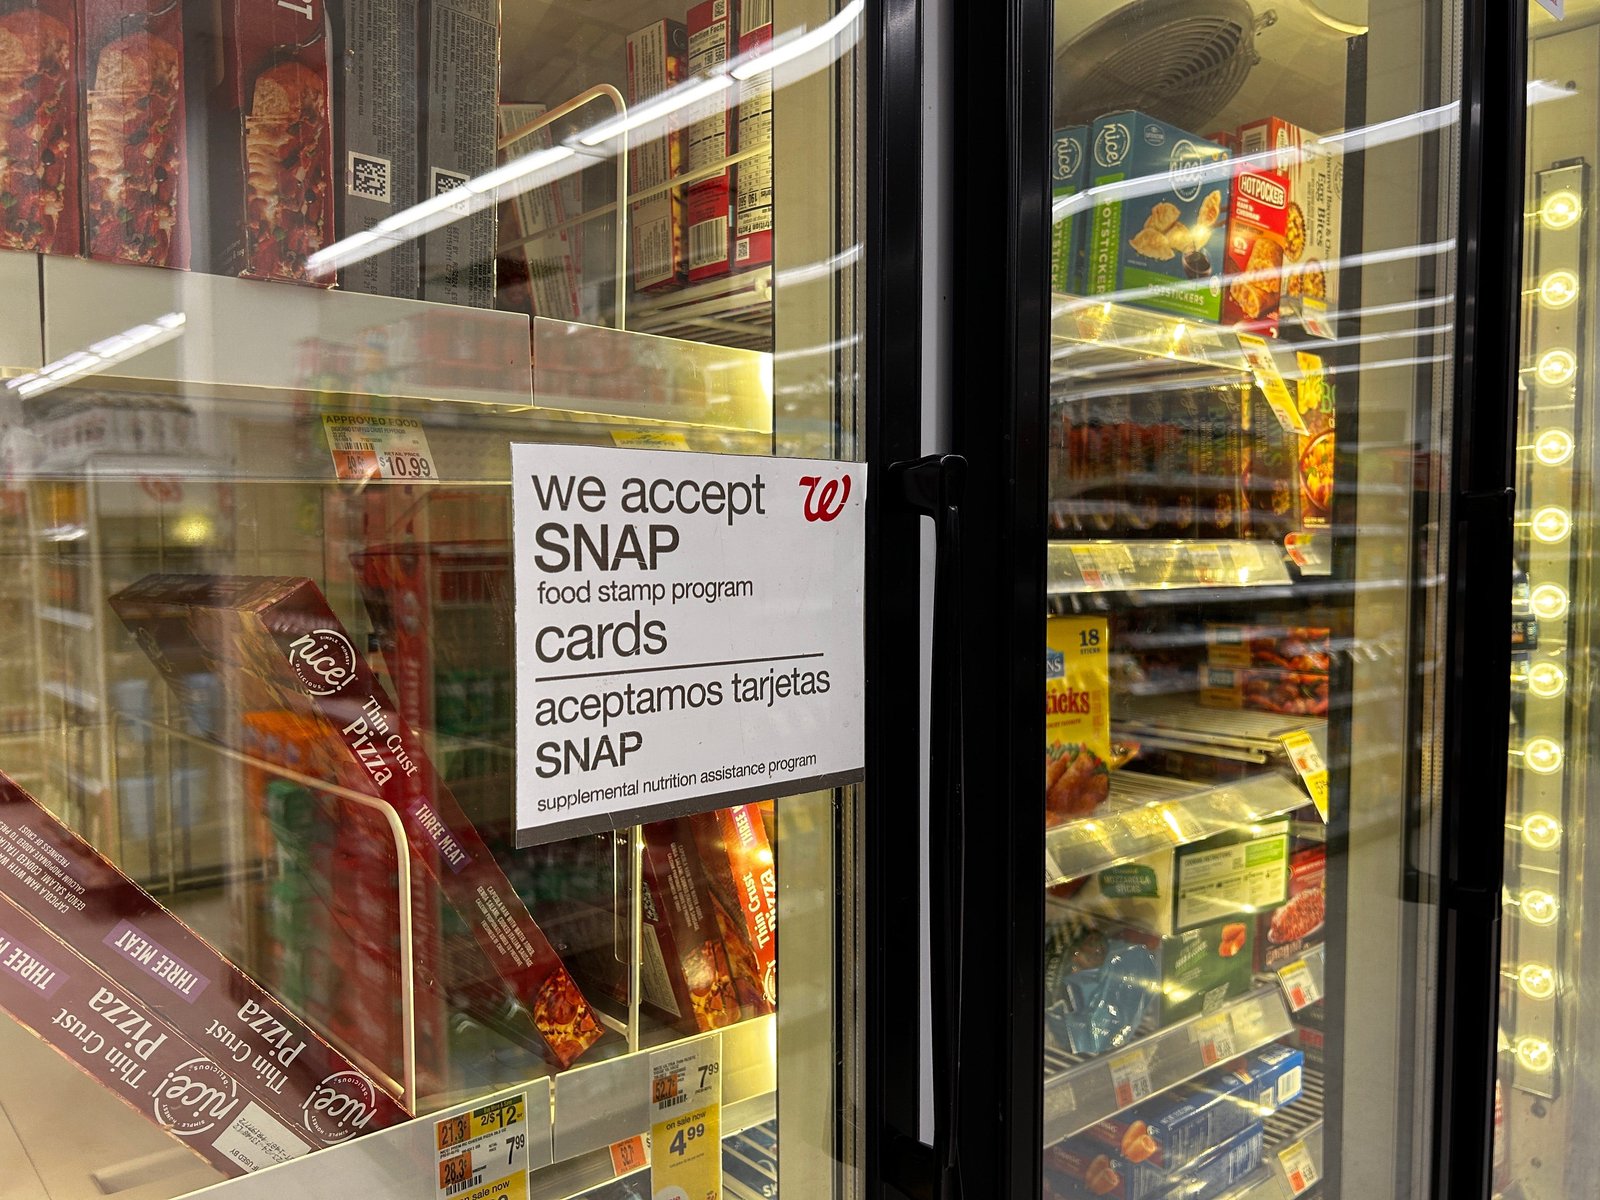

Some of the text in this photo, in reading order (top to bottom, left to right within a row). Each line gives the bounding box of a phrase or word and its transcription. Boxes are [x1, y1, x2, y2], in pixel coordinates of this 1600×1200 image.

[710, 22, 724, 34] Facts
[738, 224, 752, 234] Facts
[1096, 198, 1112, 294] POTSTICKER
[1317, 208, 1325, 247] Bites
[326, 415, 418, 428] APPROVED FOOD
[380, 456, 431, 477] $10.99
[531, 474, 766, 526] we accept
[534, 522, 680, 573] SNAP
[537, 578, 753, 606] food stamp program
[535, 610, 668, 663] cards
[1078, 628, 1100, 647] 18
[290, 634, 356, 692] nice!
[535, 667, 830, 728] aceptamos tarjetas
[1046, 687, 1090, 714] ticks
[342, 716, 393, 787] Pizza
[362, 695, 419, 778] Thin Crust
[535, 731, 644, 778] SNAP
[537, 752, 818, 812] supplemental nutrition assistance program
[10, 830, 18, 840] TO
[16, 837, 38, 857] ADDED
[18, 824, 71, 868] FRESHNESS OF CRUST
[415, 804, 466, 866] THREE MEAT
[736, 810, 754, 848] THREE
[6, 860, 28, 878] WITH
[16, 854, 43, 876] COOKED
[24, 874, 41, 892] HAM
[36, 852, 66, 878] PROPIONATE
[38, 888, 70, 914] CAPICOLA
[64, 891, 86, 911] GENOA
[66, 878, 86, 895] CALCIUM
[742, 871, 770, 950] Thin Crust
[3, 947, 56, 990] THREE
[114, 930, 198, 995] THREE MEAT
[88, 986, 168, 1060] Pizza
[237, 998, 307, 1068] Pizza
[52, 1008, 147, 1090] Thin Crust
[205, 1019, 290, 1095] Thin Crust
[193, 1064, 228, 1088] DELICIOUS
[336, 1078, 370, 1100] DELICIOUS
[152, 1072, 239, 1120] nice!
[302, 1085, 378, 1130] nice!
[666, 1111, 708, 1131] on sale now
[230, 1148, 242, 1160] BY
[238, 1153, 254, 1168] USED
[492, 1180, 510, 1194] now
